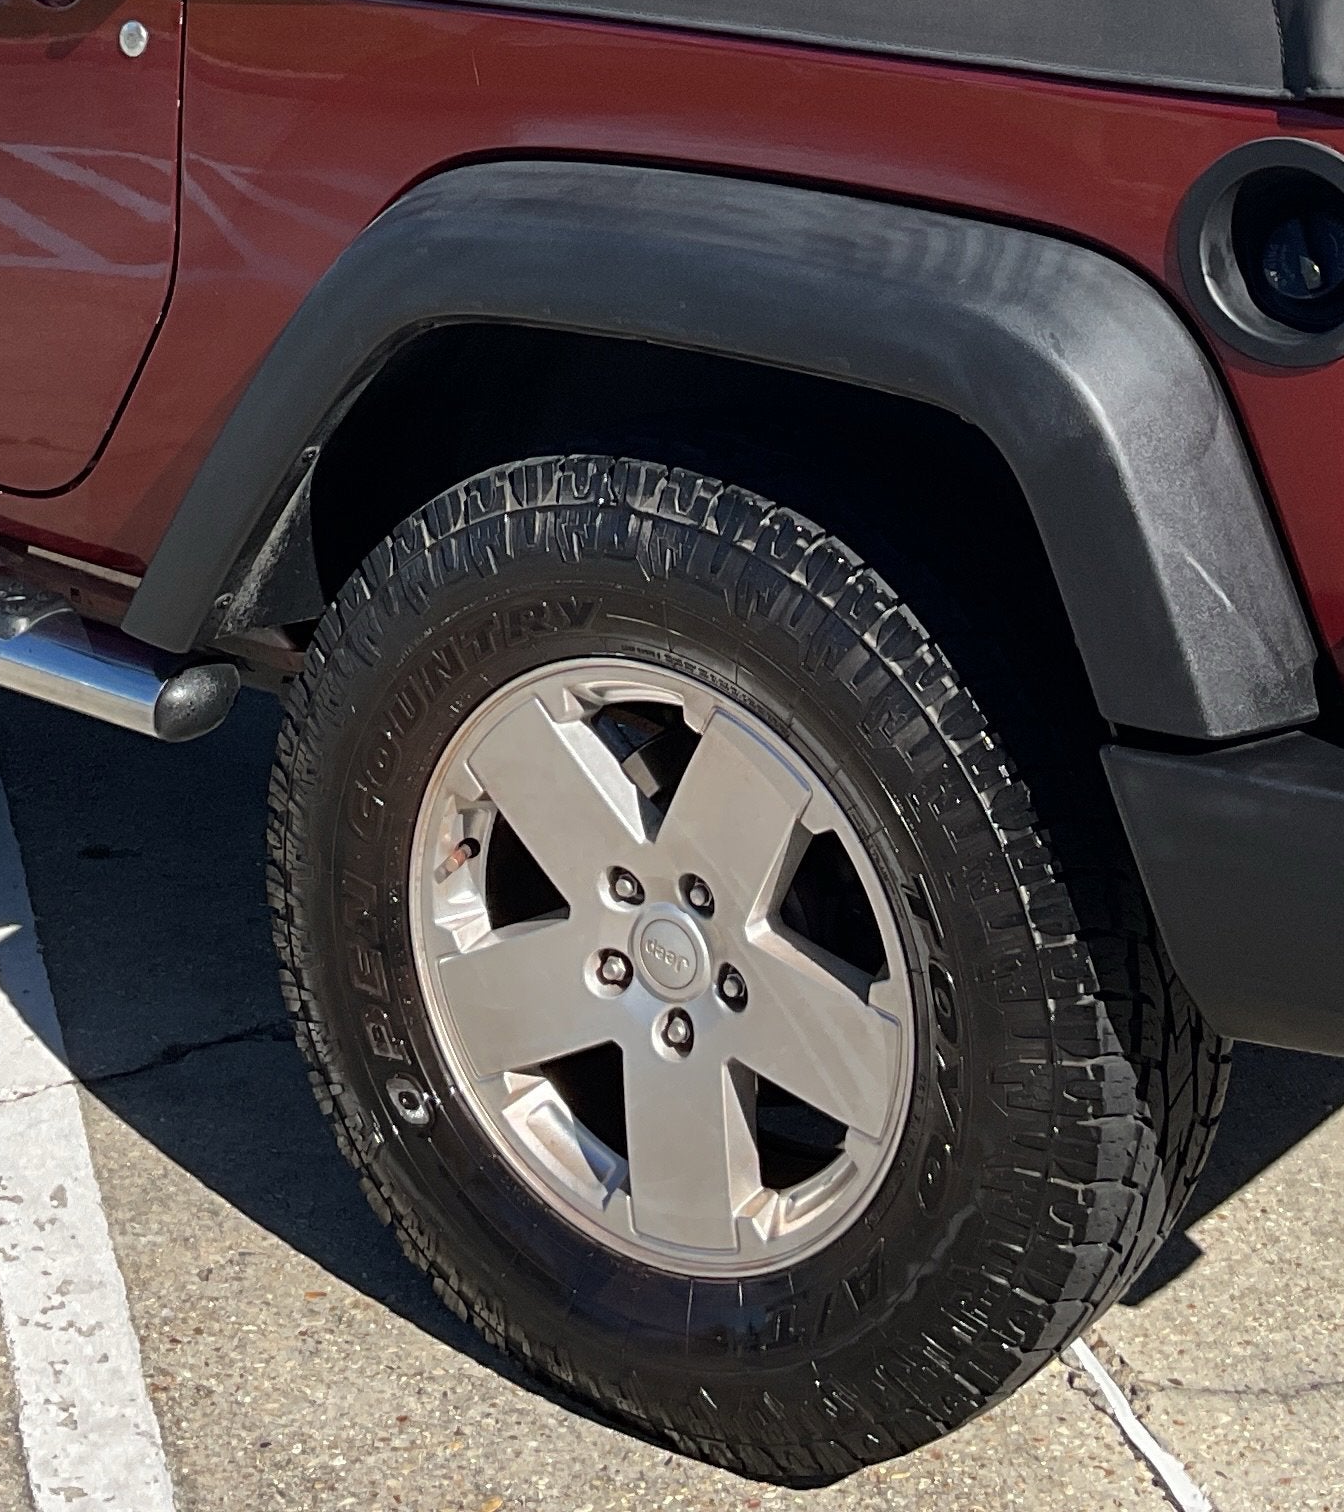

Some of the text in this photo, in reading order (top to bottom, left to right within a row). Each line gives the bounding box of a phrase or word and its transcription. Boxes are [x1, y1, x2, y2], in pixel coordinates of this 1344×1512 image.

[340, 594, 607, 1130] OPEN COUNTRY
[893, 870, 963, 1221] TOYO
